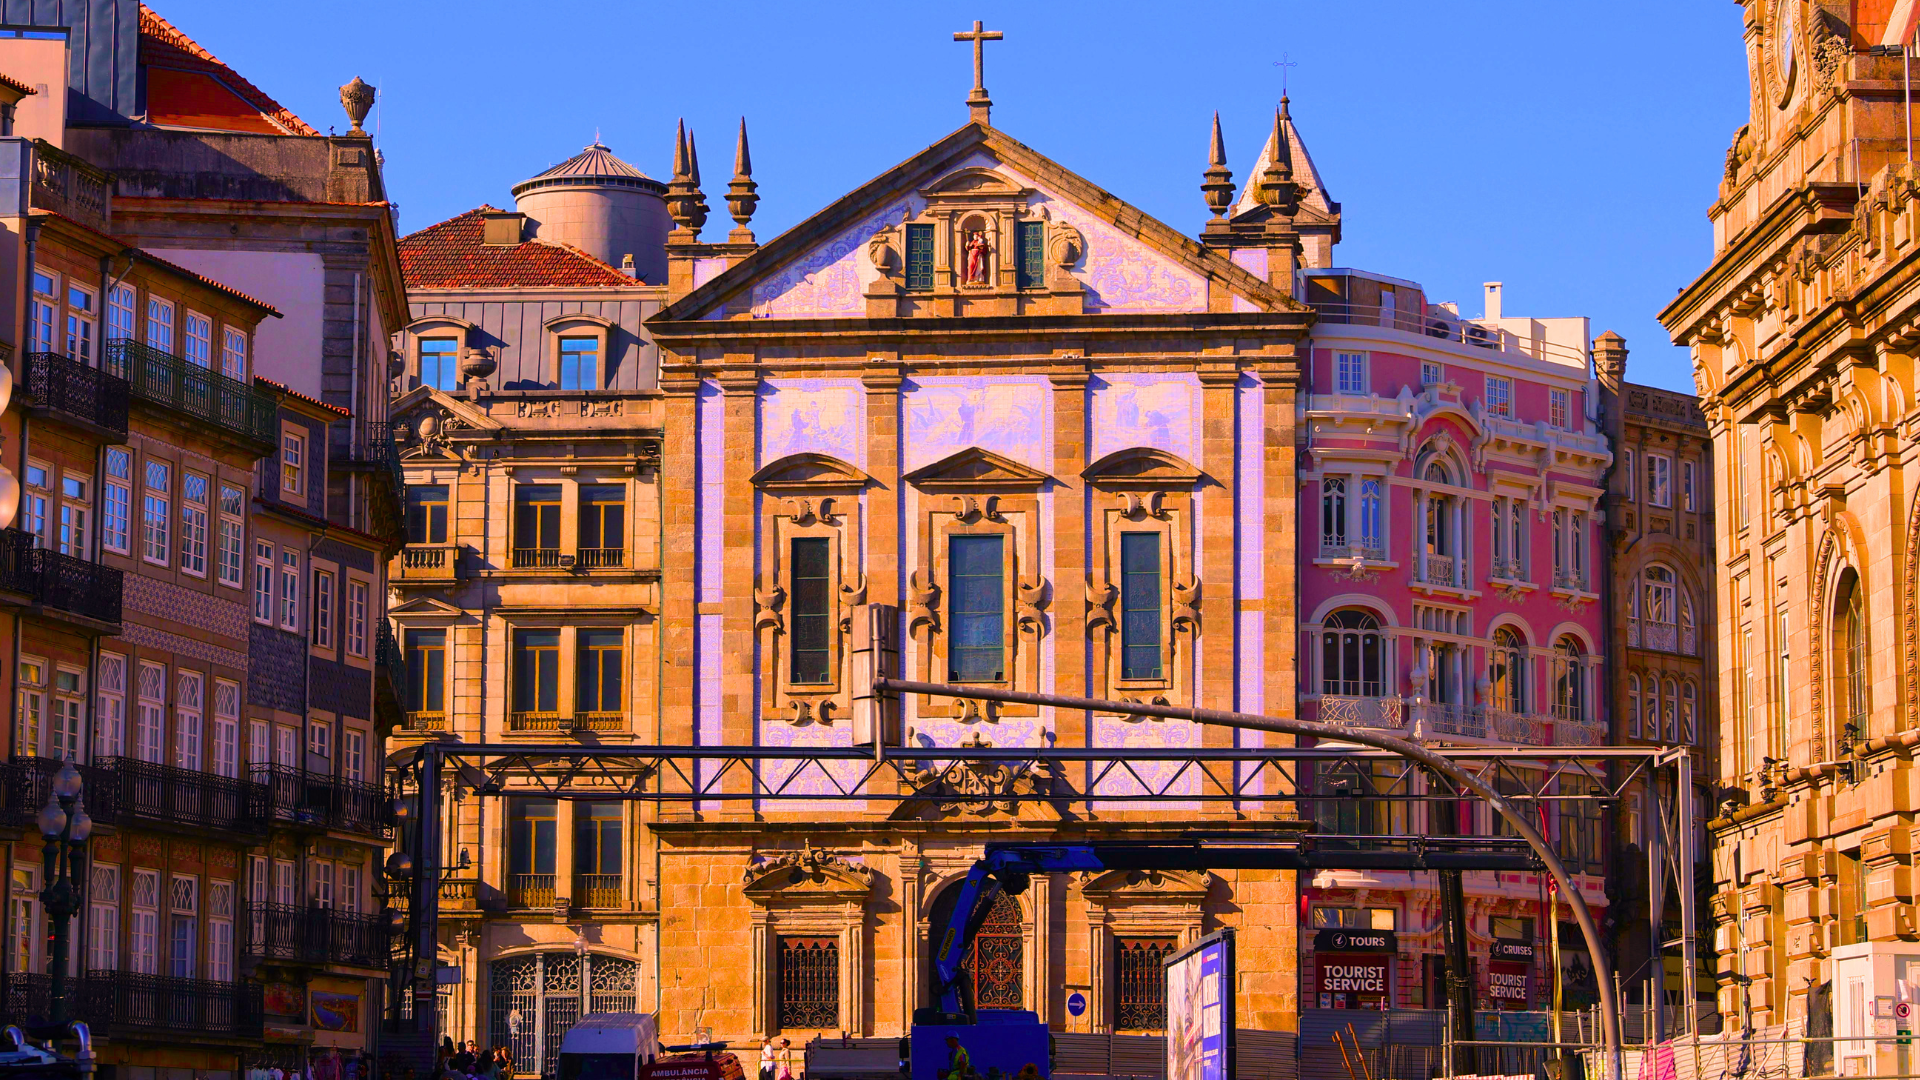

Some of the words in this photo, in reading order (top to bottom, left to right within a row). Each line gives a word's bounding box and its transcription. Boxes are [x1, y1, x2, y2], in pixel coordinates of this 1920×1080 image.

[1349, 936, 1386, 947] TOURS
[1502, 944, 1533, 956] CRUISES
[1323, 965, 1385, 979] TOURIST
[1323, 978, 1384, 991] SERVICE
[1489, 972, 1527, 987] TOURIST
[1489, 985, 1526, 1000] SERVICE
[650, 1067, 709, 1077] AMBULÂNCIA
